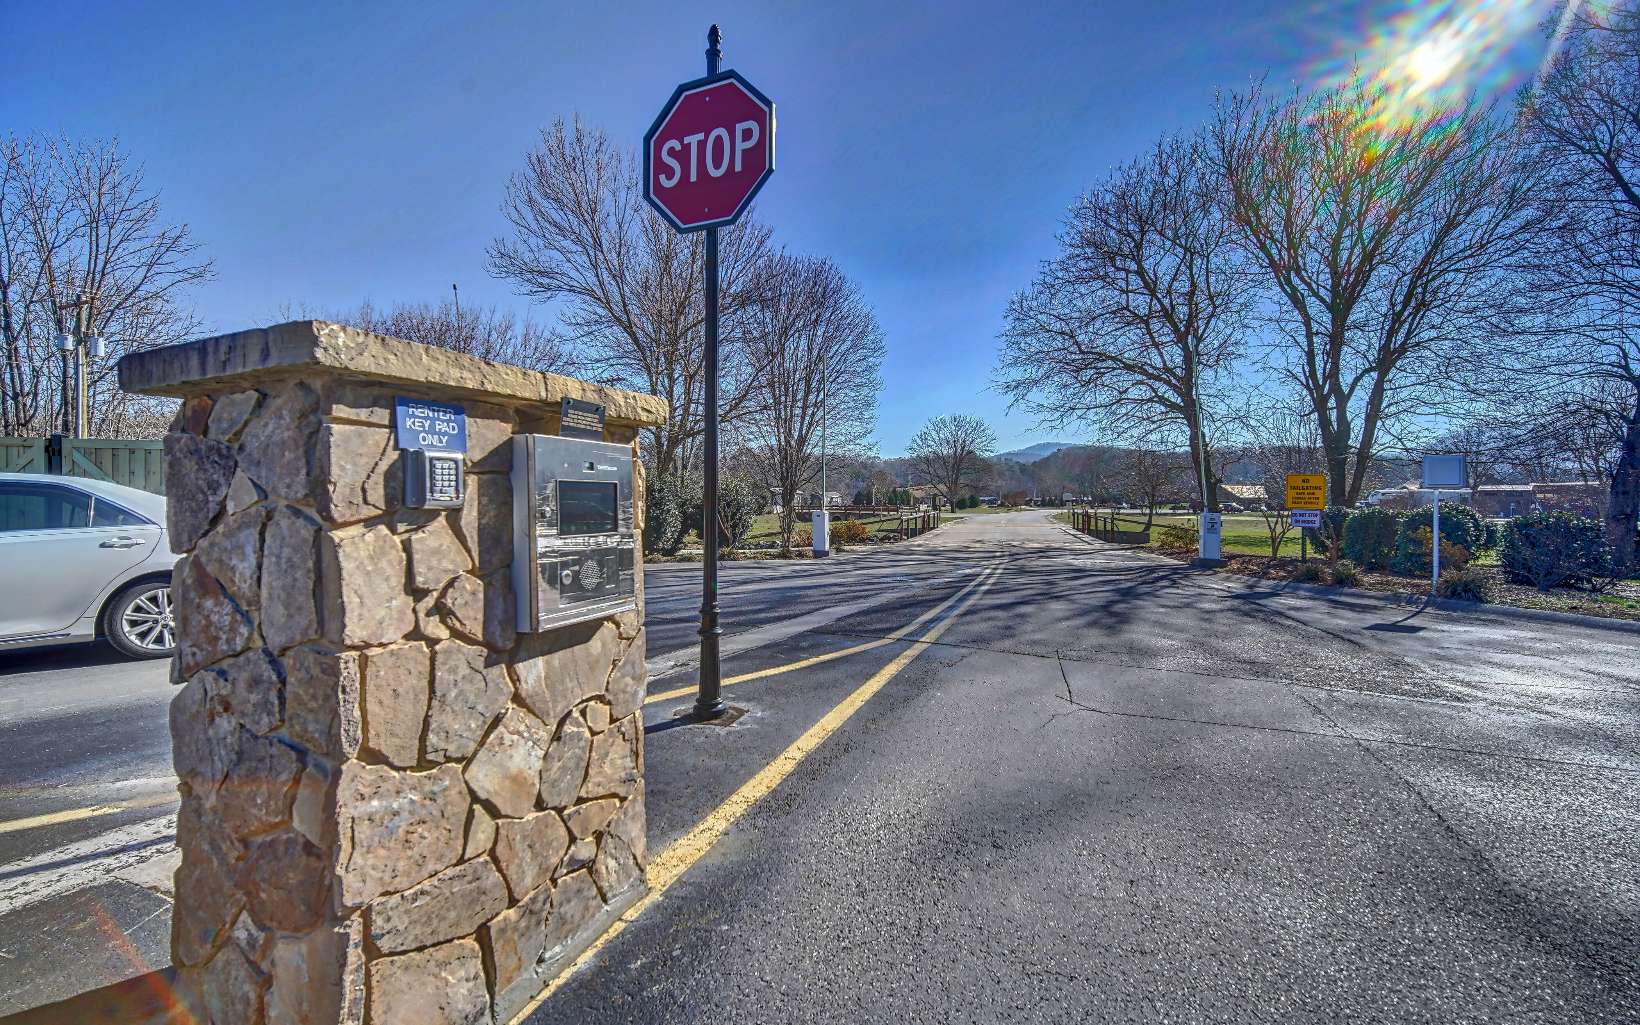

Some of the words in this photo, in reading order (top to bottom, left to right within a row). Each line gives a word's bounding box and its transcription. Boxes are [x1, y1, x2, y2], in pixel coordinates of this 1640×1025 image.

[658, 120, 760, 189] STOP
[409, 403, 455, 420] RENTER
[405, 417, 431, 431] KEY
[435, 420, 459, 434] PAD
[418, 432, 449, 446] ONLY
